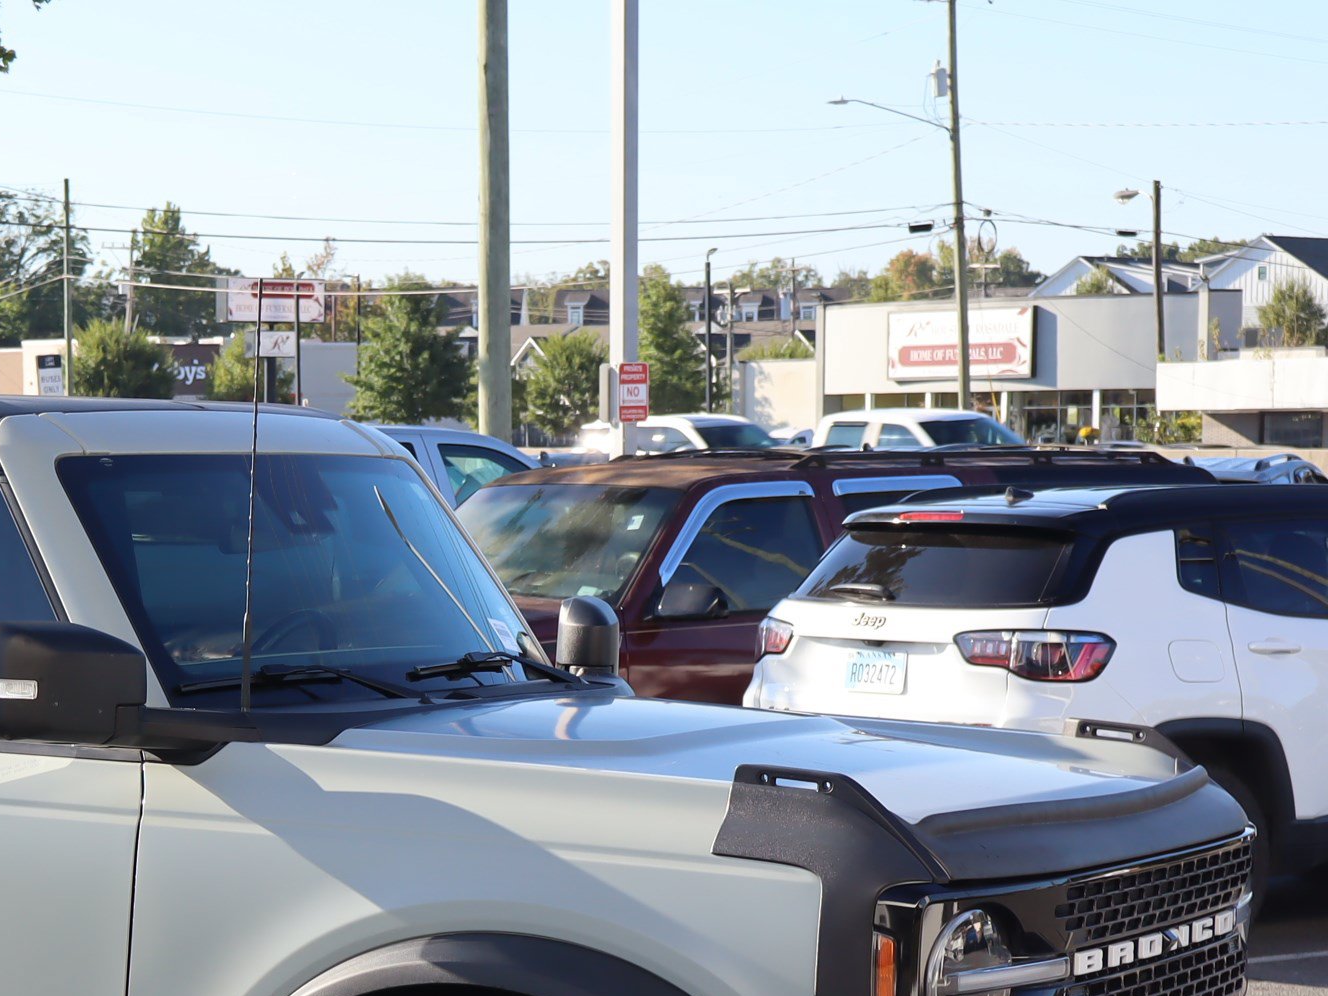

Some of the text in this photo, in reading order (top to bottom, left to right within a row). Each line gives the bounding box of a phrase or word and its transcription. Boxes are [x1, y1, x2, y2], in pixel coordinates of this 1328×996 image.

[910, 350, 931, 361] HOME
[933, 350, 945, 361] OF
[626, 386, 640, 398] NO
[853, 612, 887, 630] Jeep
[1074, 908, 1235, 976] BRONCO
